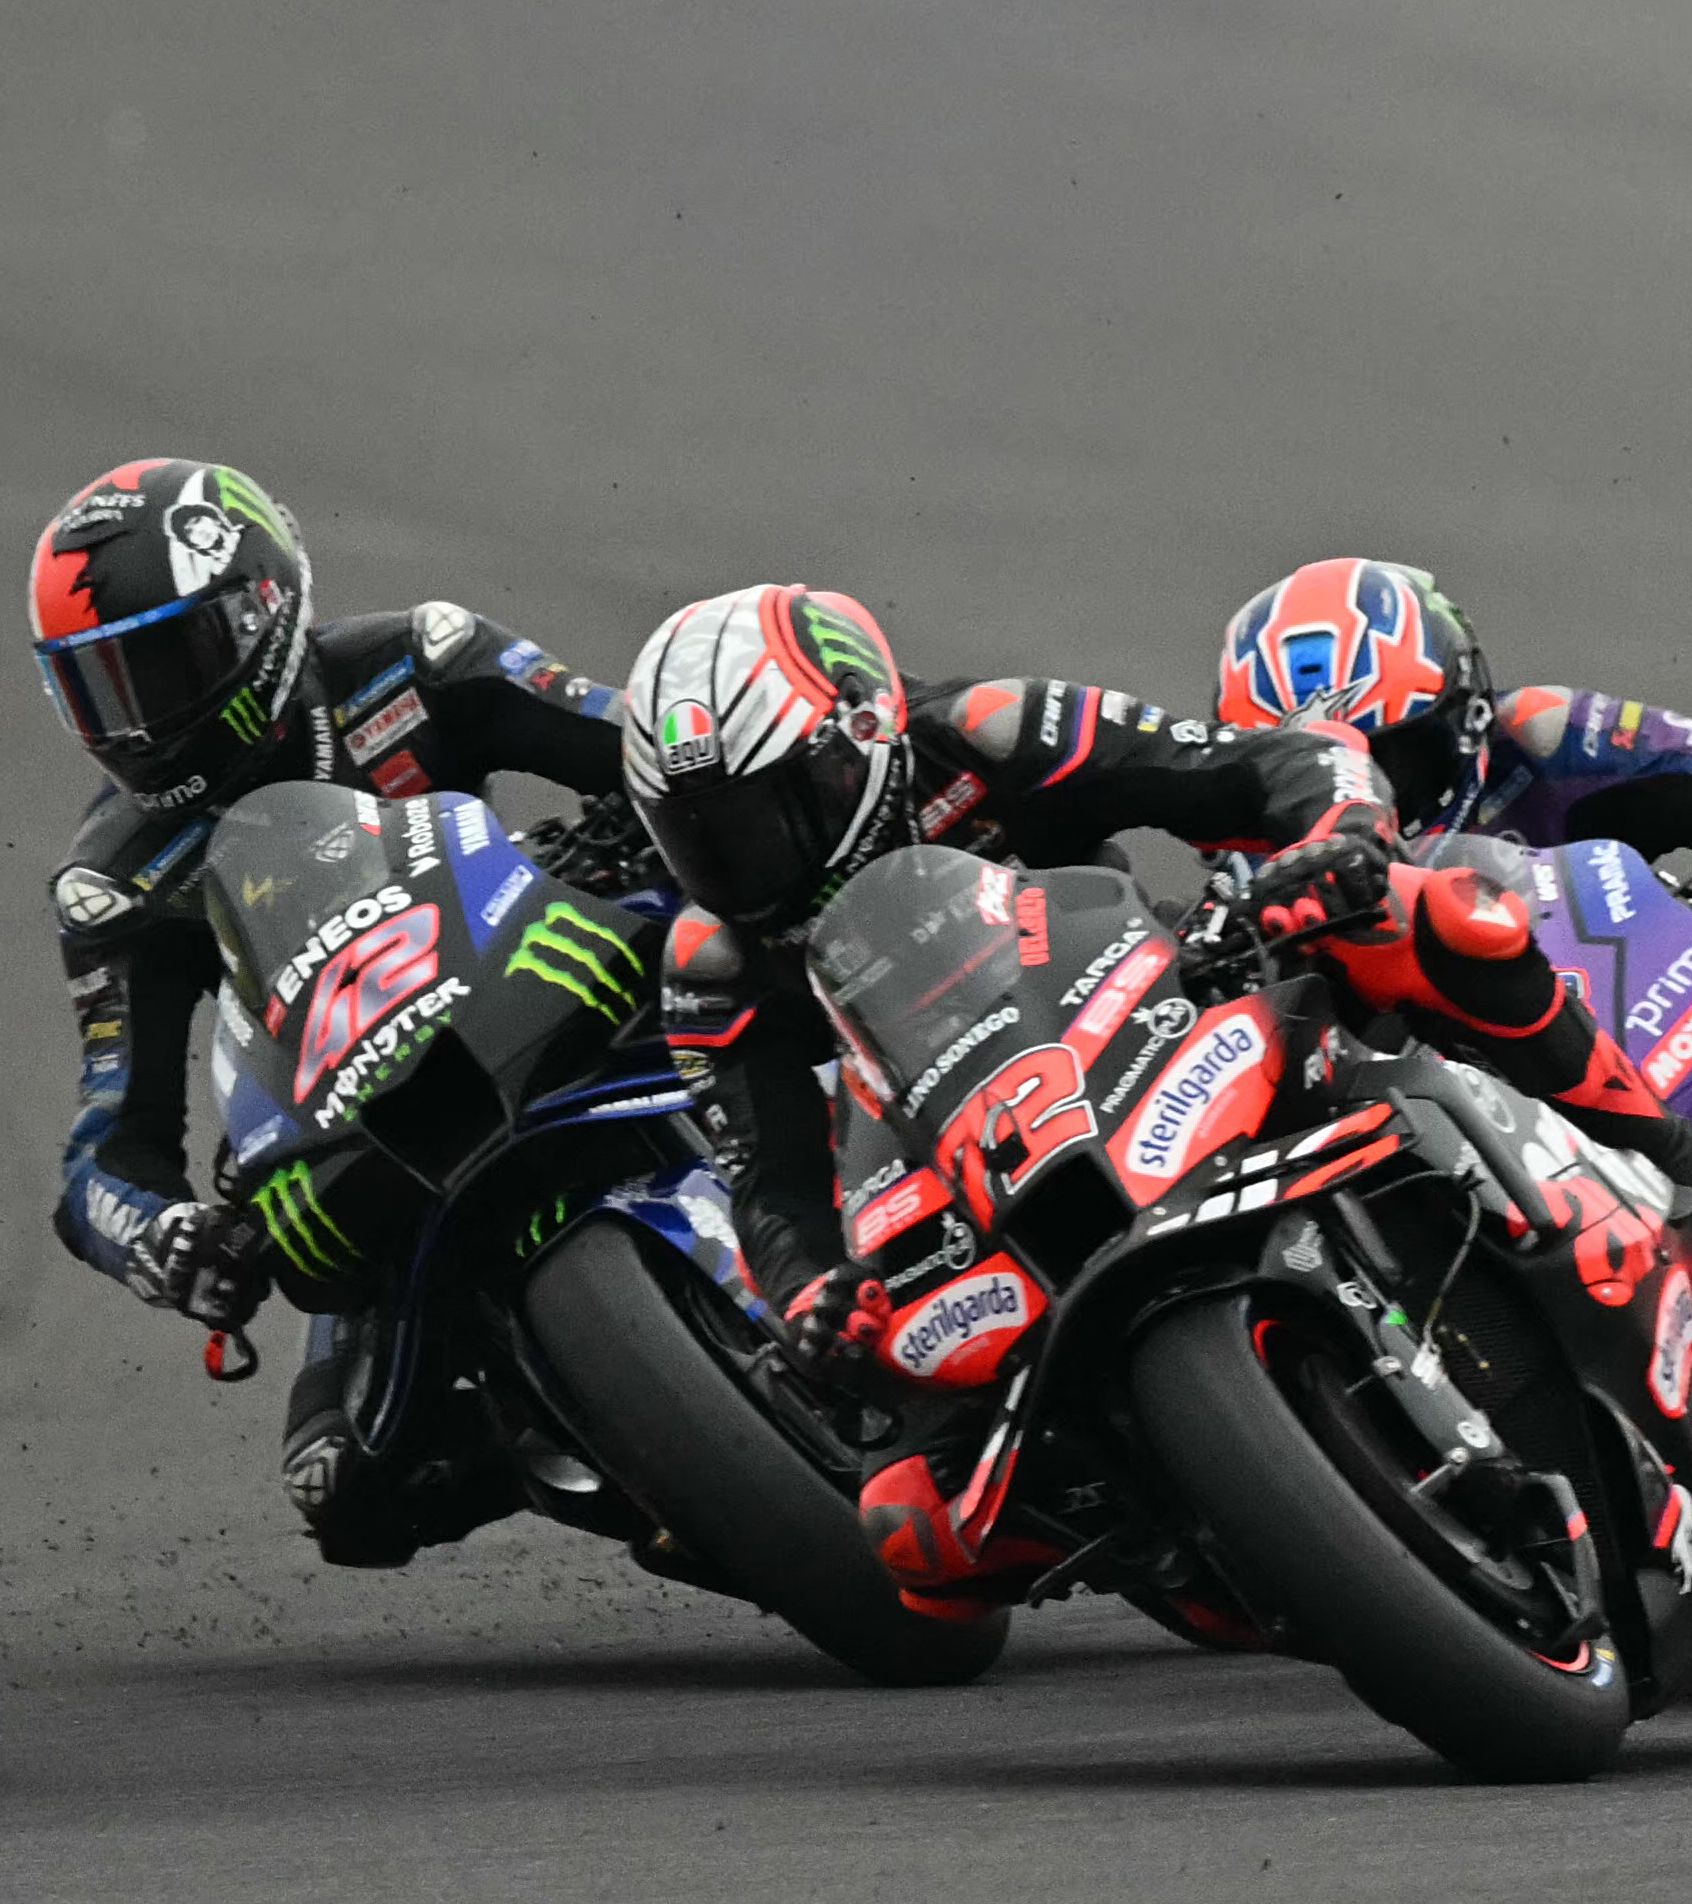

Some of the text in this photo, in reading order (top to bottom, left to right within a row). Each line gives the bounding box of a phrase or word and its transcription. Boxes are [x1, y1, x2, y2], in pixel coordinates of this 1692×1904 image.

[310, 705, 334, 780] YAMAHA
[275, 884, 412, 1004] ENEOS
[1059, 930, 1150, 1006] TARGA
[293, 902, 441, 1105] 42
[1079, 953, 1160, 1036] BS
[314, 976, 472, 1129] MONSTER
[934, 1006, 1021, 1074] SONEGO
[1098, 1034, 1168, 1114] PRAGMATIC
[934, 1042, 1099, 1232] 72
[1138, 1027, 1254, 1168] sterilgarda
[856, 1181, 922, 1247] BS
[902, 1275, 1018, 1370] sterilgarda
